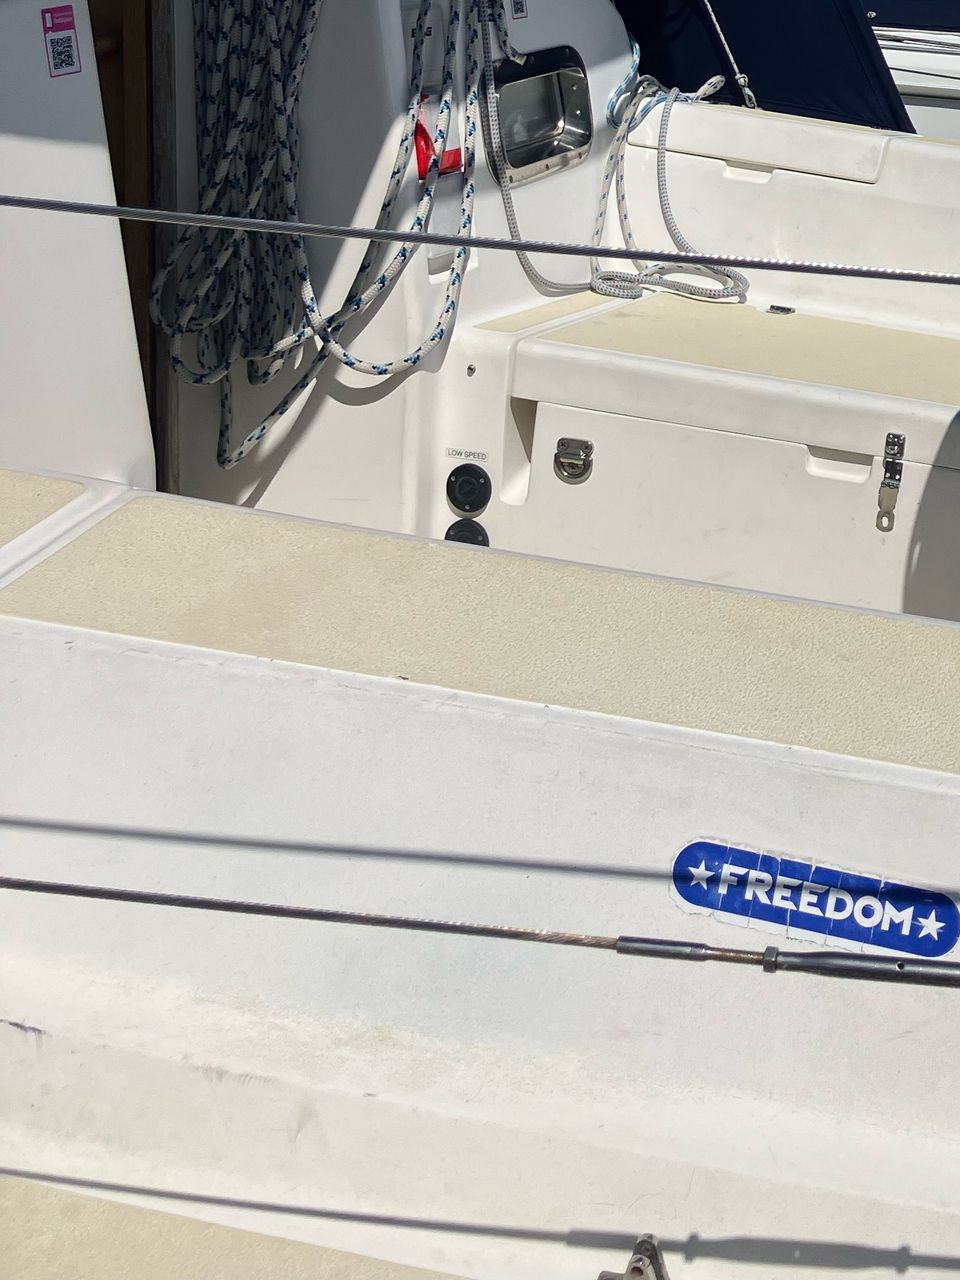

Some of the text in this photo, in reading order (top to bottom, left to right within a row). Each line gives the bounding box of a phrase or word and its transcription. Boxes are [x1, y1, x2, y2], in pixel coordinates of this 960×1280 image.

[447, 449, 487, 460] LOW SPEED
[717, 863, 915, 936] FREEDOM
